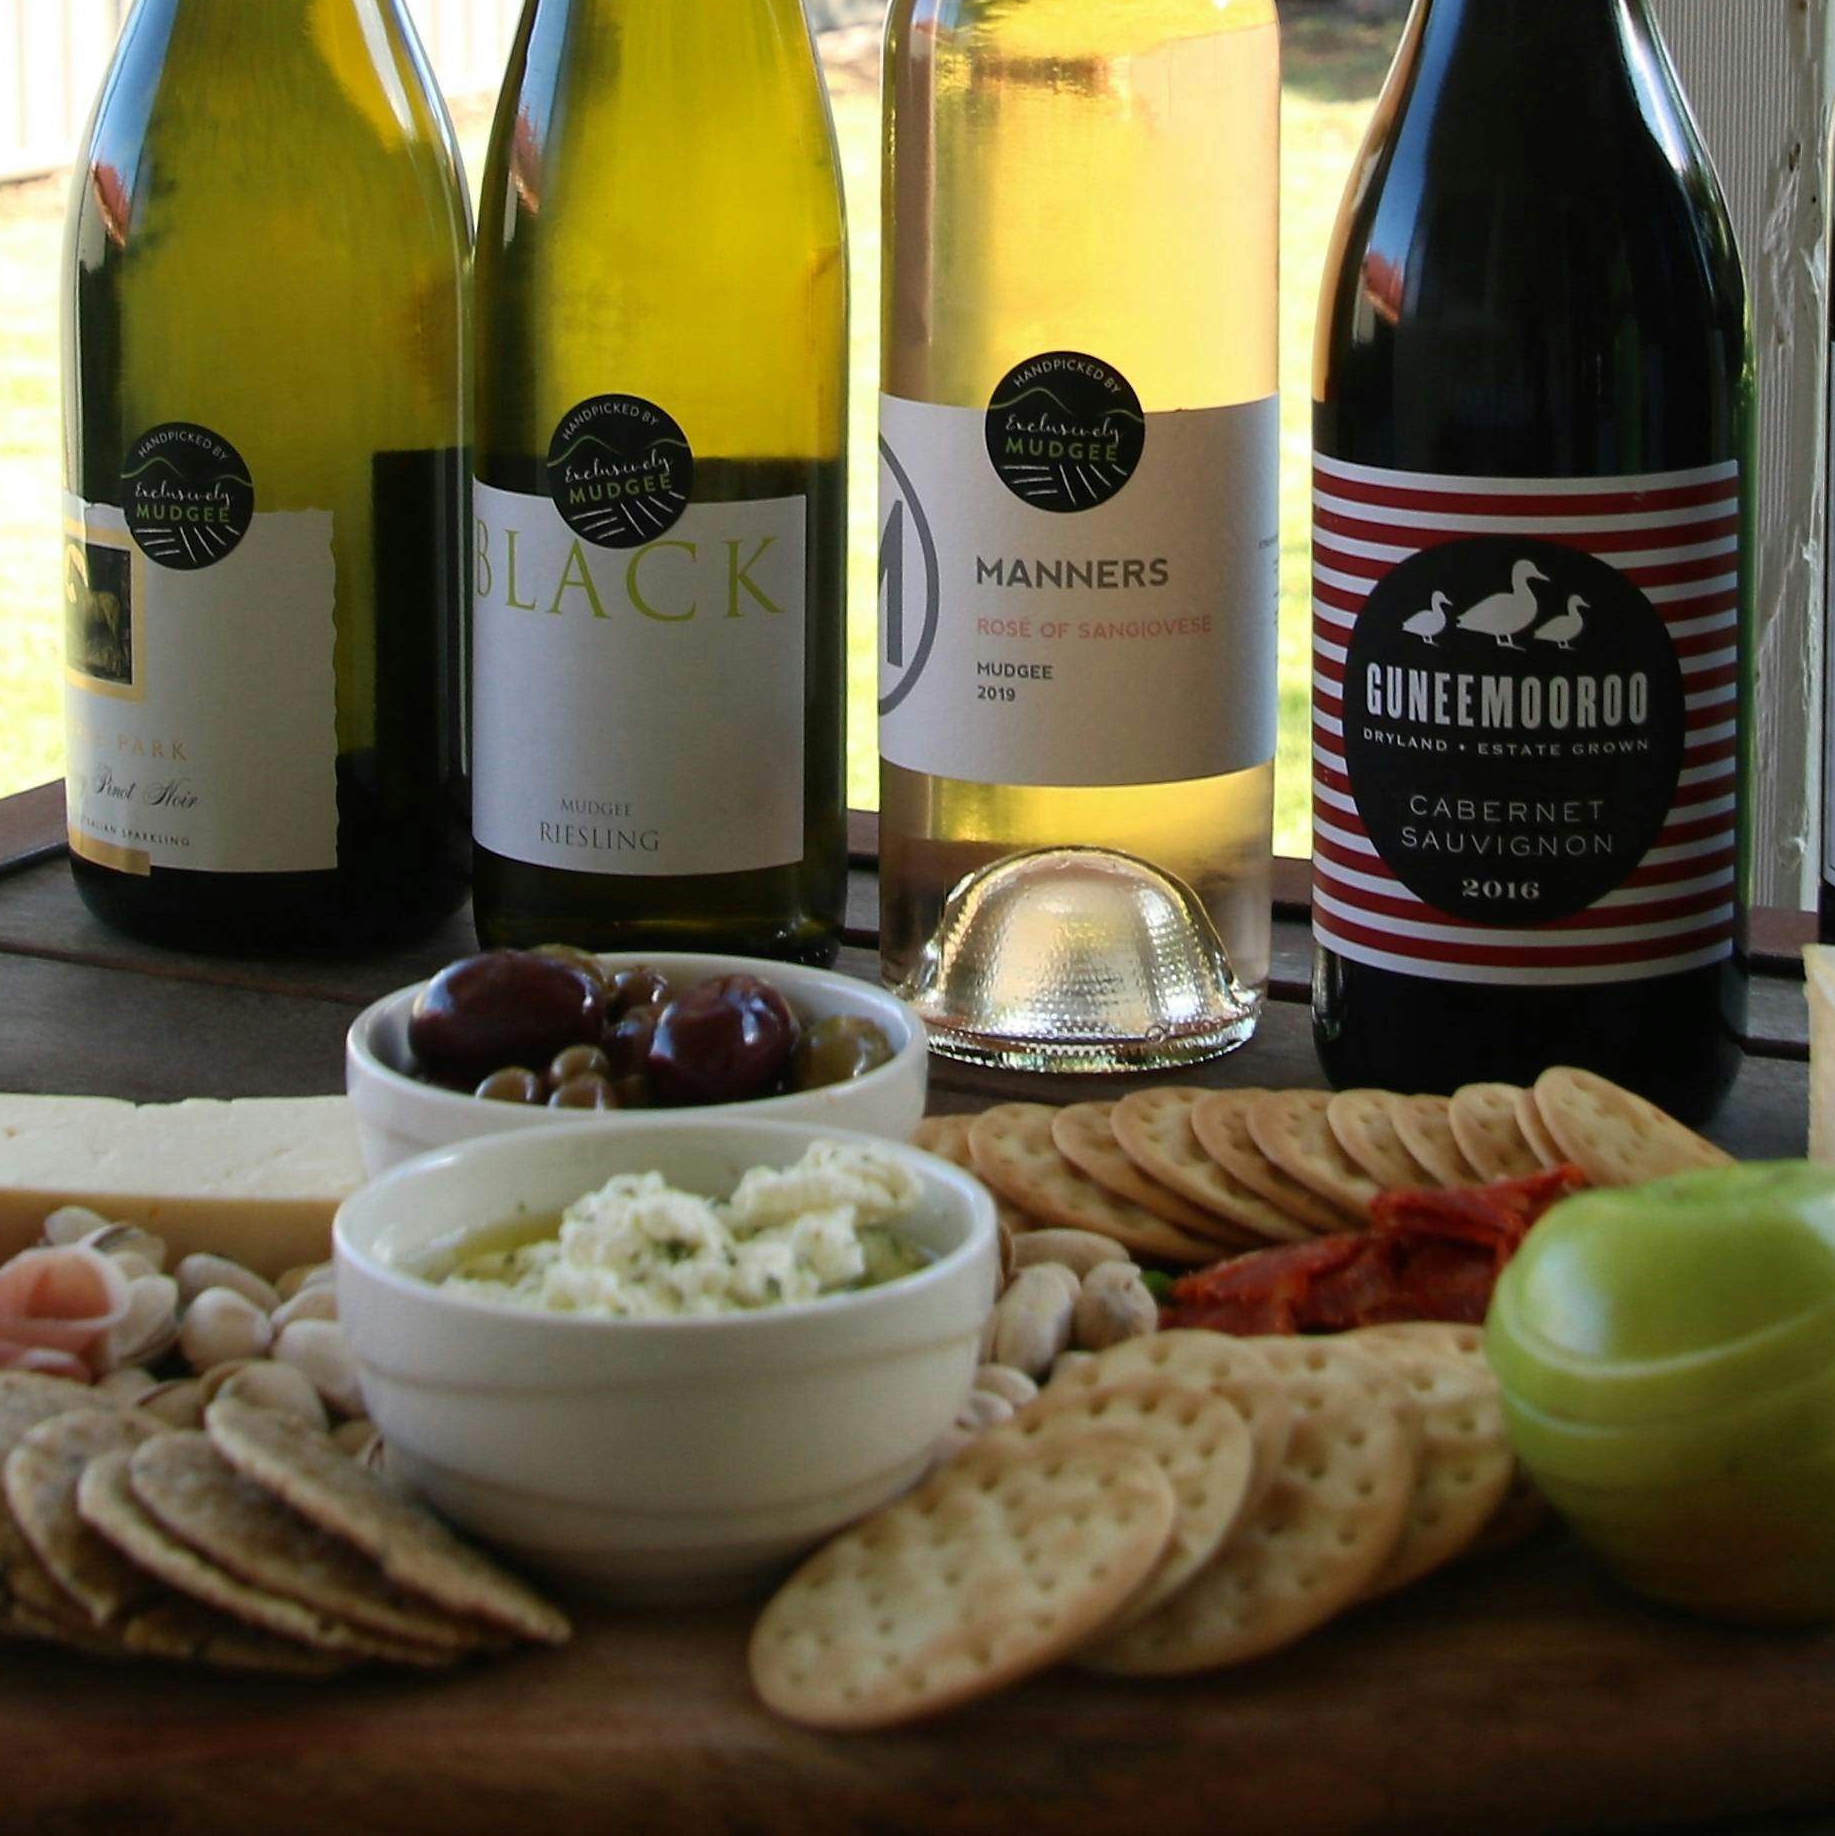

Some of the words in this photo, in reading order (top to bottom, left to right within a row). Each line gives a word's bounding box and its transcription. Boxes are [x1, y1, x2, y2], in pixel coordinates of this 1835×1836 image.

[1014, 359, 1103, 388] HANDPICKED
[1104, 377, 1121, 393] BY
[562, 403, 640, 440] HANDPICKED
[642, 411, 658, 425] BY
[1005, 413, 1120, 447] Exclusively
[138, 431, 212, 457] HANDPICKED
[212, 446, 228, 460] BY
[1006, 437, 1116, 461] MUDGEE
[565, 448, 670, 483] Exclusively
[135, 480, 230, 507] Exclusively
[570, 474, 671, 504] MUDGEE
[137, 504, 229, 522] MUDGEE
[475, 518, 785, 621] BLACK
[977, 557, 1169, 588] MANNERS
[977, 615, 1031, 638] ROSÉ
[1040, 622, 1070, 639] OF
[1078, 615, 1212, 639] SANGIOVESE
[977, 662, 1053, 680] MUDGEE
[977, 685, 1015, 702] 2019
[1367, 662, 1648, 729] GUNEEMOOROO
[118, 733, 186, 761] PARK
[1364, 728, 1447, 752] DRYLAND
[1478, 743, 1560, 756] ESTATE
[1572, 740, 1649, 755] GROWN
[96, 764, 136, 799] Pinot
[148, 779, 198, 808] Noir
[561, 799, 633, 817] MUDGEE
[1410, 795, 1604, 822] CABERNET
[122, 828, 189, 846] SPARKLING
[540, 821, 659, 852] RIESLING
[1401, 826, 1612, 856] SAUVIGNON
[1462, 879, 1540, 899] 2016
